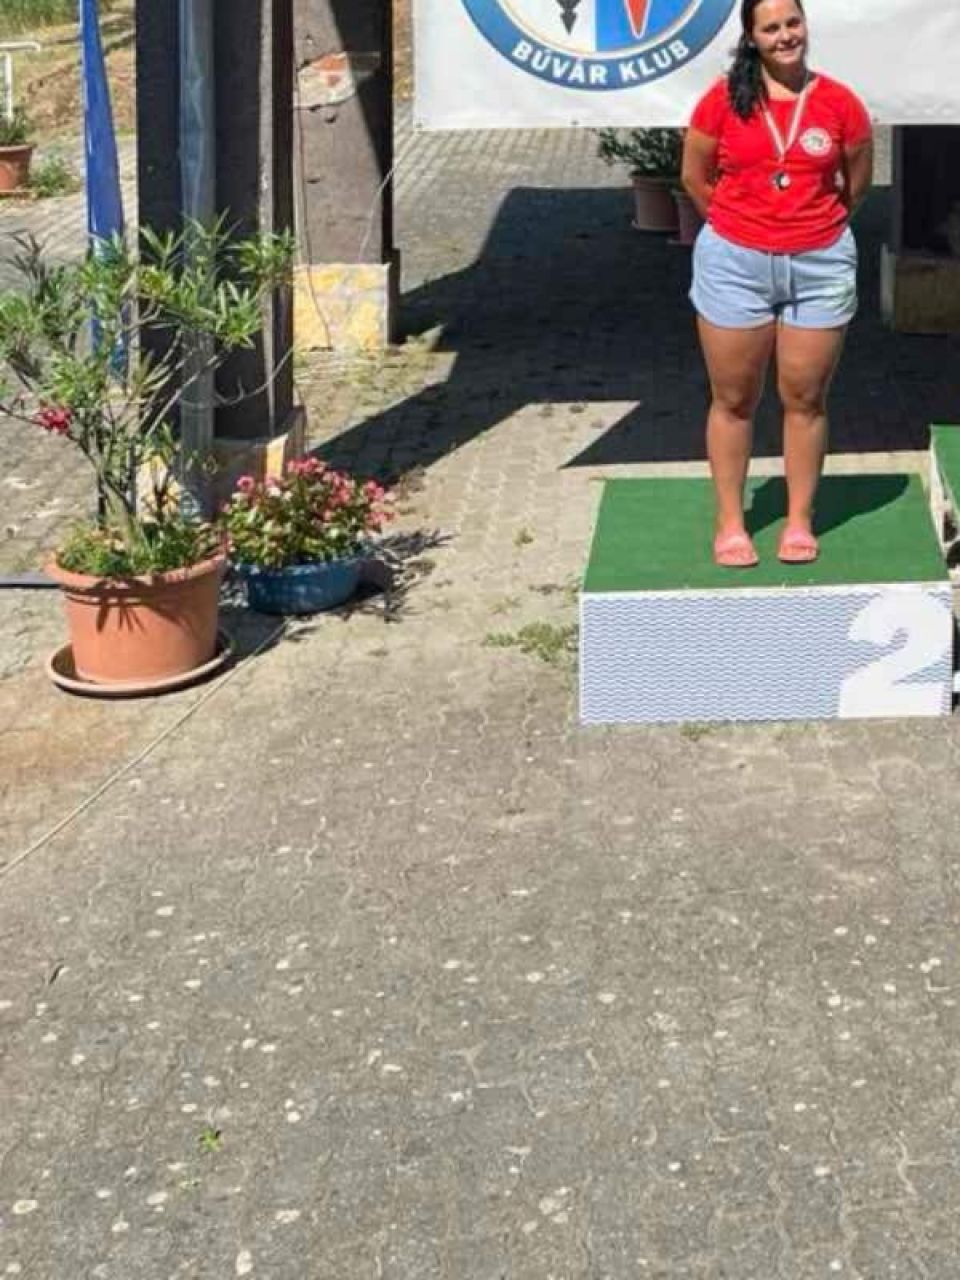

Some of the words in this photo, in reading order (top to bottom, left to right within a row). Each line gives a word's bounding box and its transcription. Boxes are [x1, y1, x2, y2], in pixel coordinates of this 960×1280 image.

[511, 39, 609, 86] BÚVÁR
[618, 39, 691, 82] KLUB
[838, 588, 952, 718] 2
